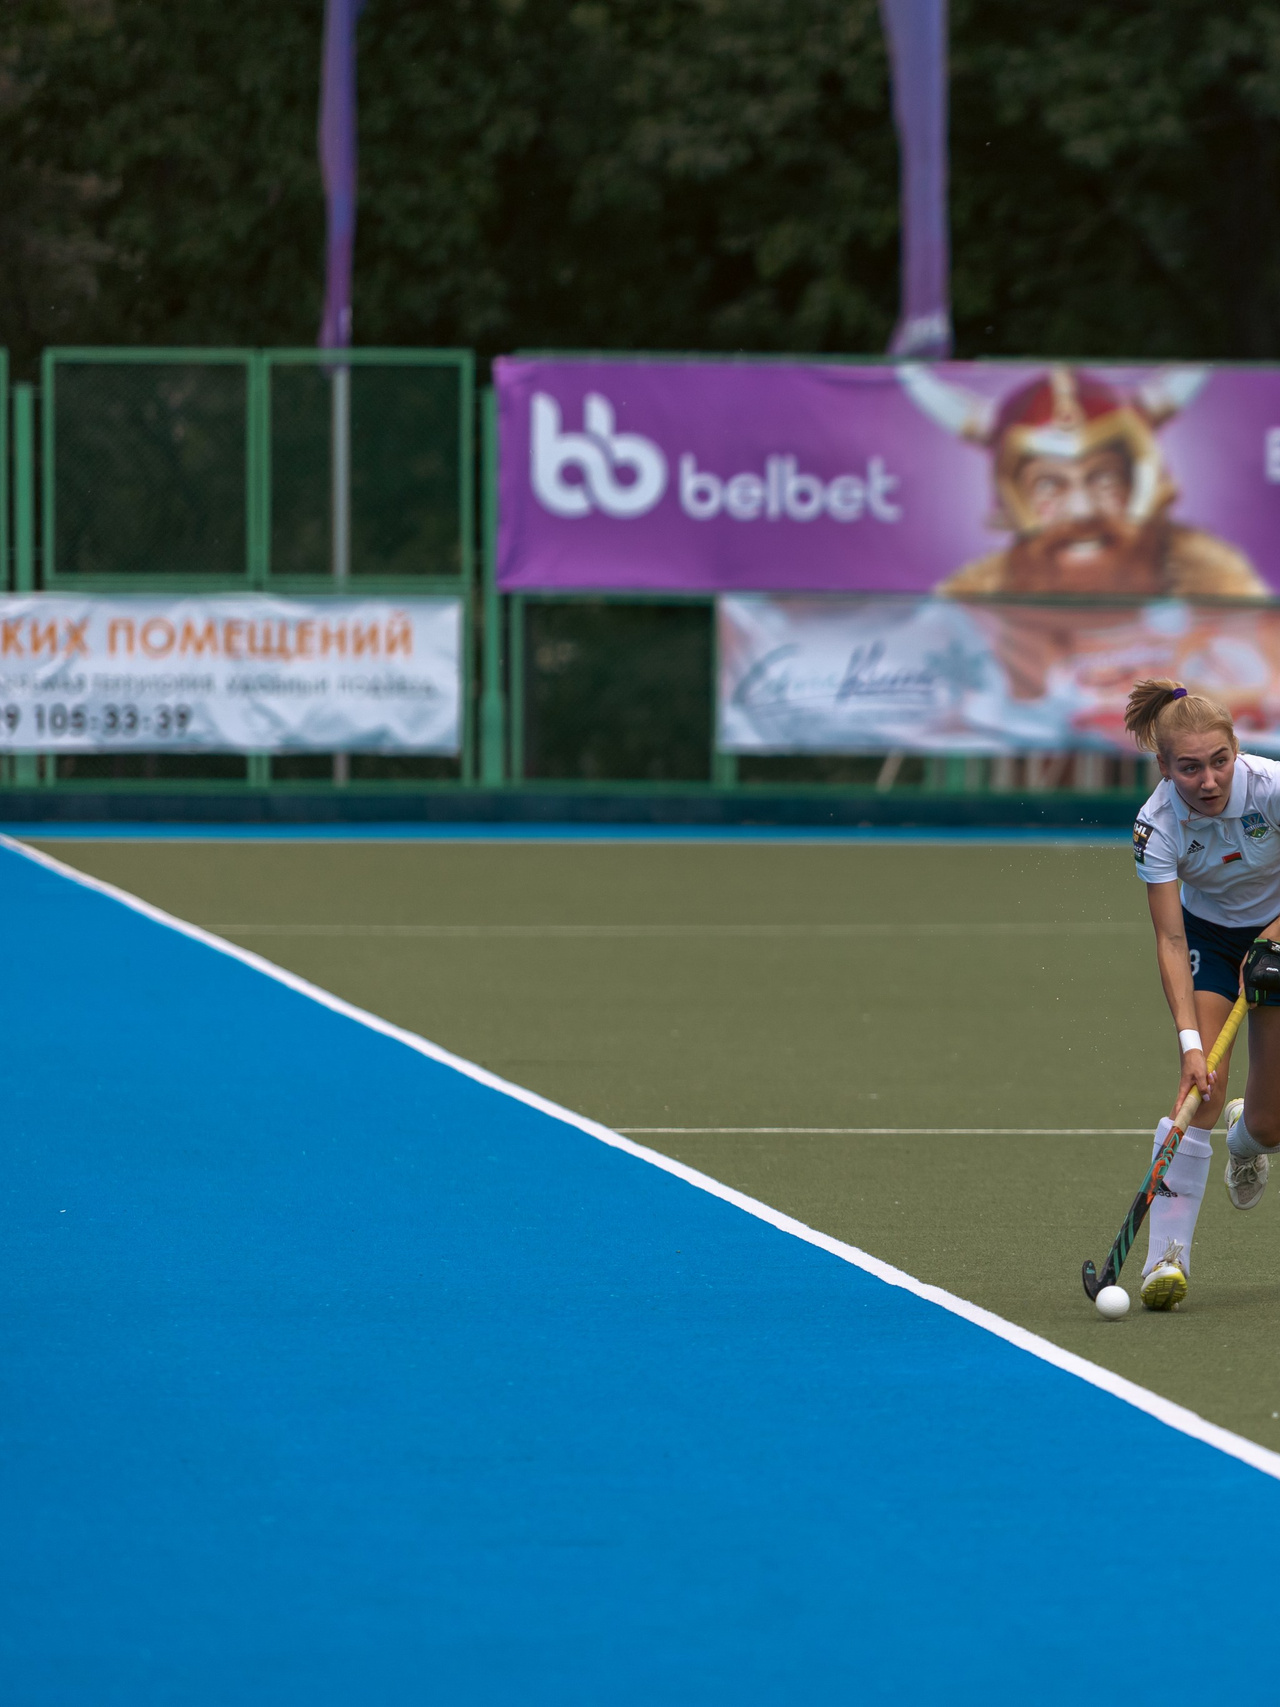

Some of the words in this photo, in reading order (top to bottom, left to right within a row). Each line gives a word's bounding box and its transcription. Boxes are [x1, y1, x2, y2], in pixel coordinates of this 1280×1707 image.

[680, 452, 902, 521] belbet
[1, 617, 89, 659] КИХ
[106, 611, 414, 664] ПОМЕЩЕНИЙ
